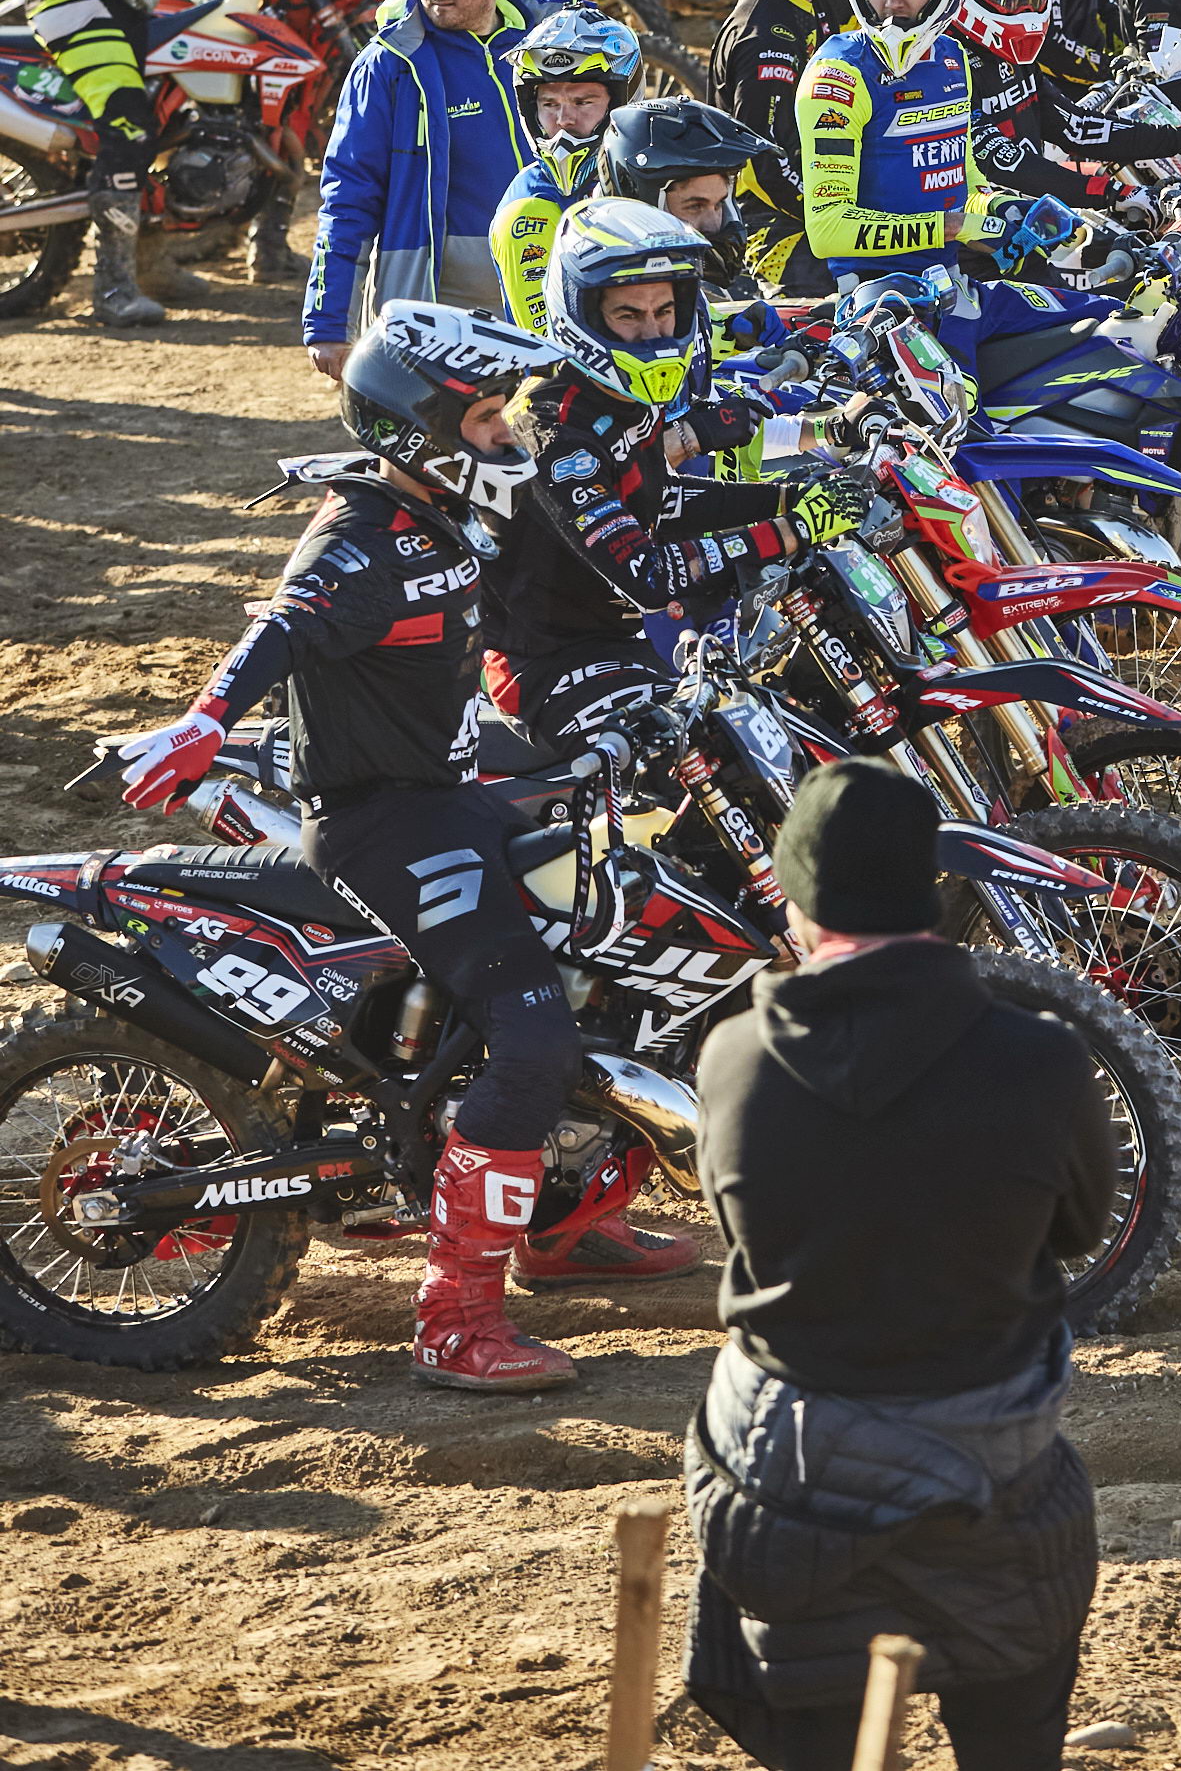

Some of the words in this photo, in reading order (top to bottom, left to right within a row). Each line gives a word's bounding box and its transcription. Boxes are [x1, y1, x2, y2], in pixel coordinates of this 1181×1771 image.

[813, 84, 851, 101] BS
[897, 100, 971, 126] SHERCO
[924, 166, 965, 190] MOTUL
[854, 221, 936, 251] KENNY
[1142, 447, 1166, 456] MOTUL
[997, 576, 1084, 598] Beta
[1002, 595, 1060, 615] EXTREME
[1077, 695, 1148, 722] RIEJU
[180, 868, 224, 879] ALFREDO
[225, 870, 260, 880] GOMEZ
[990, 869, 1067, 892] RIEJU
[193, 1173, 313, 1210] Mitas
[484, 1170, 536, 1226] G
